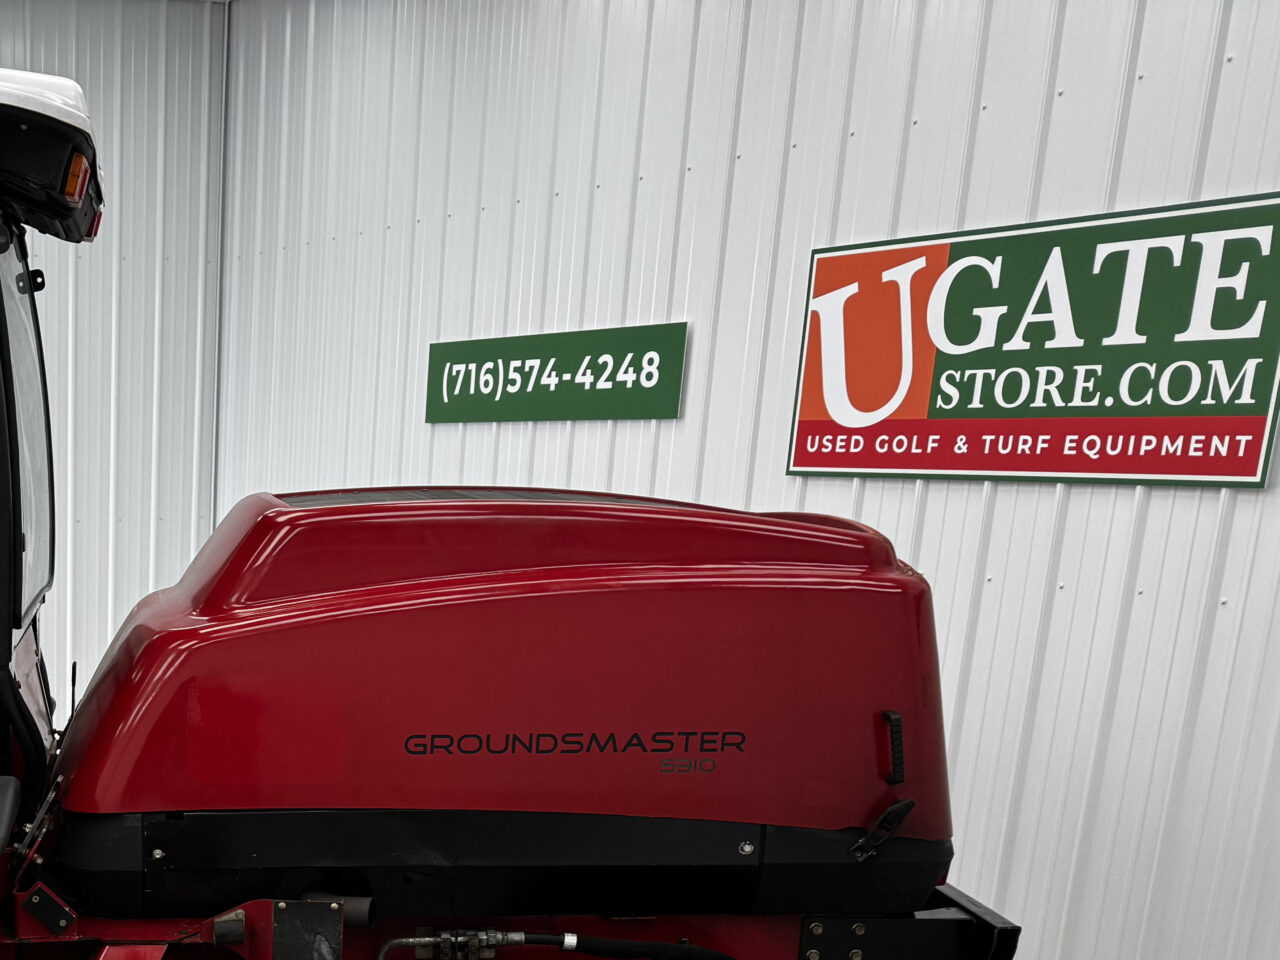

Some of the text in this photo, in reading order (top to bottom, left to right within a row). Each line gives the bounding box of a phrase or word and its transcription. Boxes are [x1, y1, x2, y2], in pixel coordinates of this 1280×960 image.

[442, 350, 660, 403] (716)574-4248
[936, 358, 1263, 410] STORE.COM
[806, 434, 1253, 460] USED GOLF & TURF EQUIPMENT
[404, 731, 747, 756] GROUNDSMASTER
[659, 758, 717, 774] 5910
